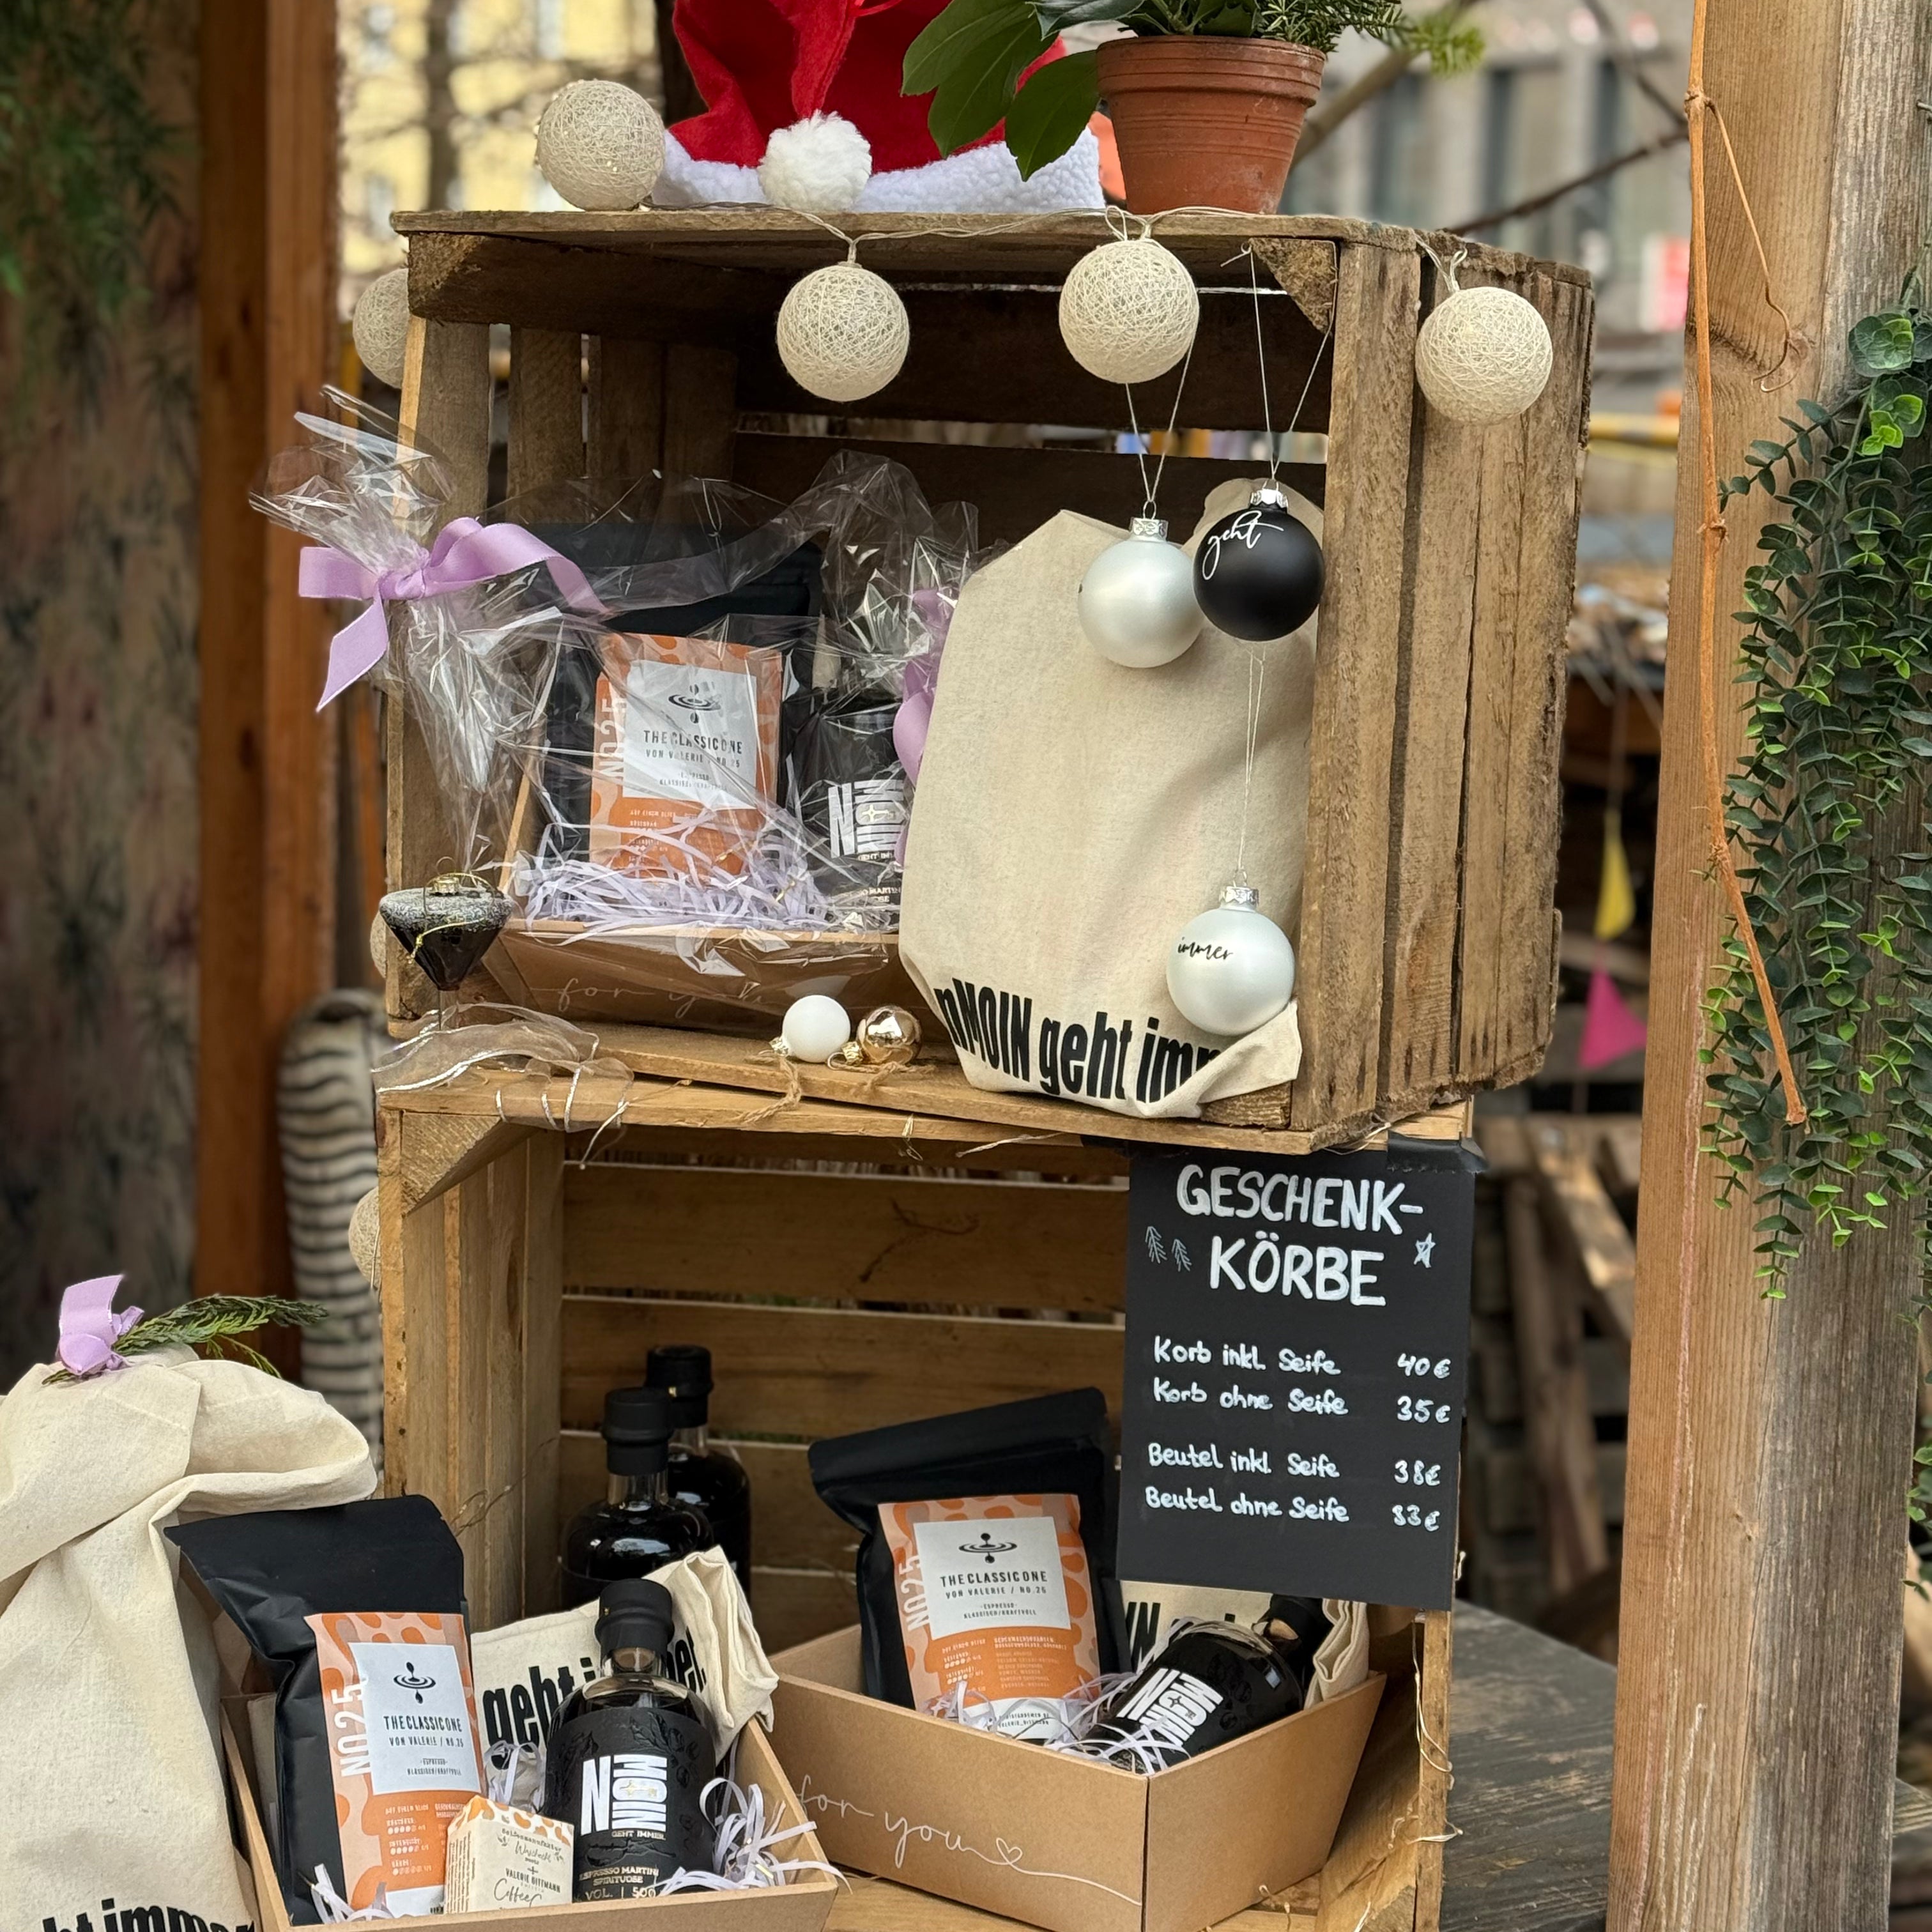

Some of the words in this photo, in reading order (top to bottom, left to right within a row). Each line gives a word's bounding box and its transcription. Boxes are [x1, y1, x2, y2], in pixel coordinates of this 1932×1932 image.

[1177, 937, 1234, 960] immer
[1039, 1012, 1131, 1100] geht
[1177, 1164, 1423, 1235] GESCHENK-
[1209, 1230, 1386, 1307] KÖRBE
[1154, 1335, 1212, 1364] Korb
[1278, 1348, 1342, 1375] Seife
[1153, 1377, 1208, 1403] Korb
[1219, 1384, 1273, 1410] ohne
[1287, 1388, 1349, 1415] Seife
[1148, 1442, 1224, 1469] Beutel
[1287, 1452, 1340, 1478] Seife
[1145, 1485, 1223, 1512] Beutel
[1230, 1492, 1283, 1518] ohne
[1288, 1496, 1350, 1522] Seife
[946, 1589, 963, 1600] VON
[968, 1586, 1006, 1596] VALERIE
[389, 1736, 406, 1747] VON
[408, 1736, 438, 1746] VALERIE
[885, 1812, 971, 1868] you
